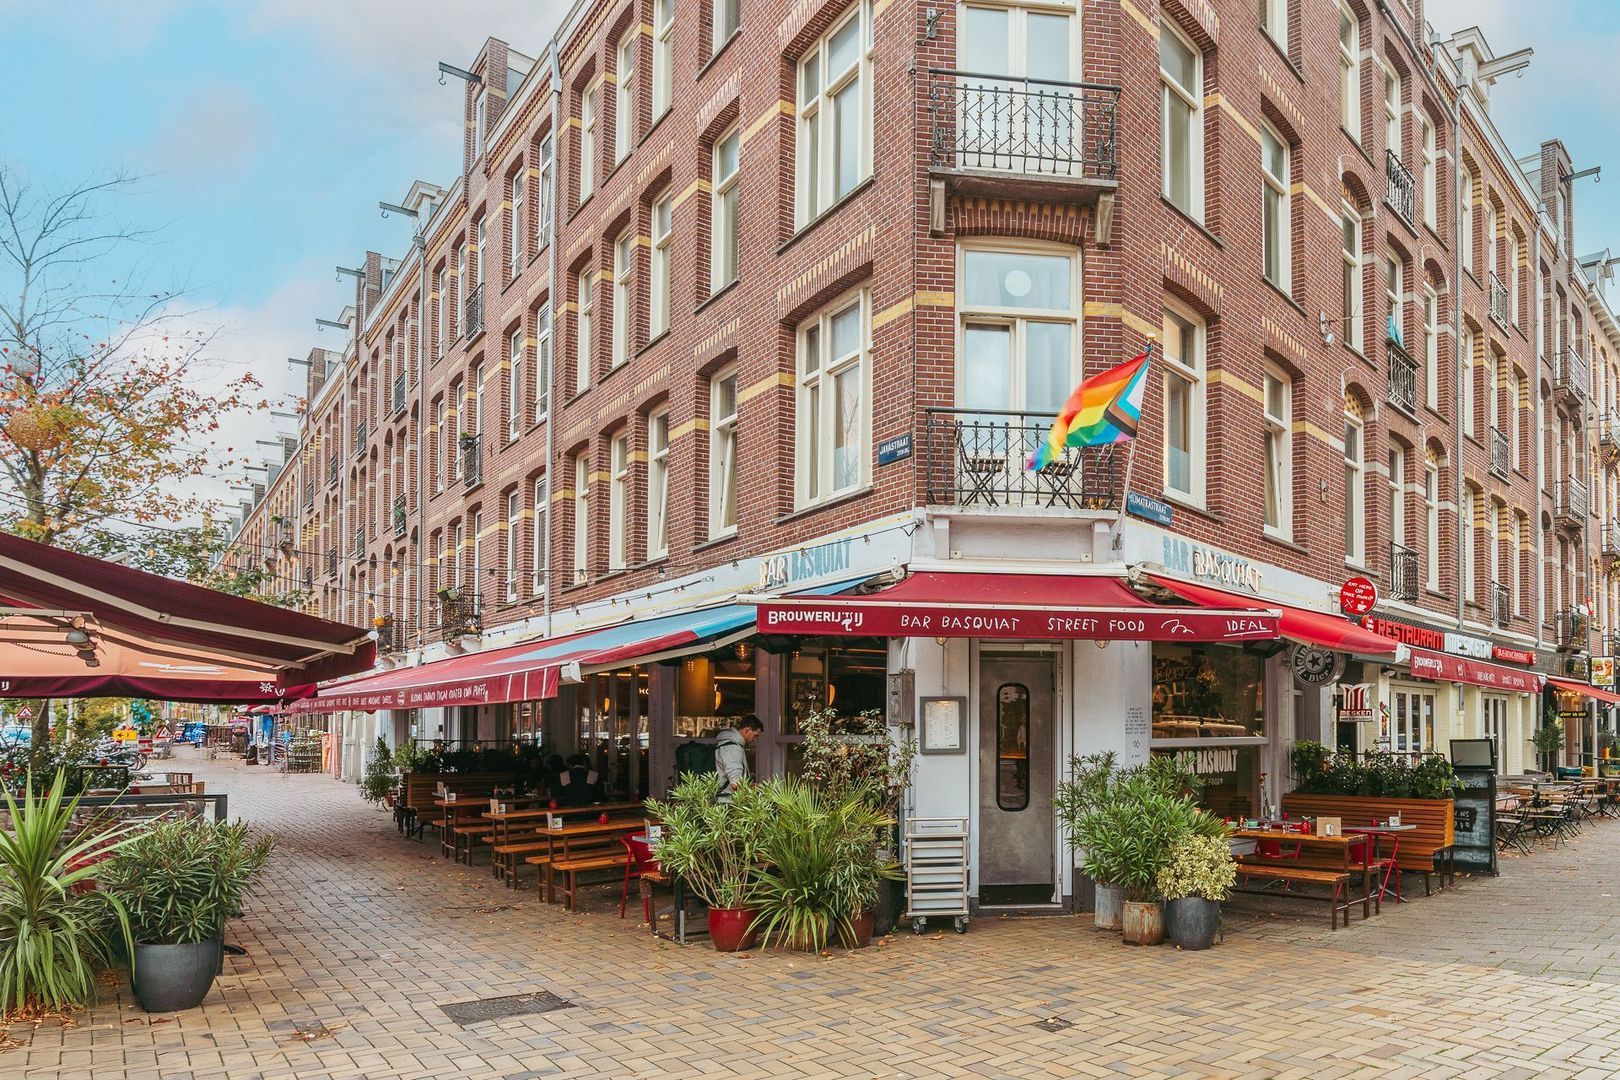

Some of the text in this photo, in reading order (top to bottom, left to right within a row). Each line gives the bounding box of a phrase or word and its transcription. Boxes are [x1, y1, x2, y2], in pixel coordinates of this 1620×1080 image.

[880, 436, 909, 455] JAVASTRAAT
[760, 537, 852, 587] BAR BASQUIAT
[1163, 535, 1263, 594] BAR BASQUIAT
[768, 611, 841, 625] BROUWERIJ
[901, 614, 1020, 631] BAR BASQUIAT
[1048, 617, 1145, 632] STREET FOOD
[1227, 619, 1268, 630] IDEAL
[1309, 670, 1329, 682] Bier
[1196, 750, 1237, 774] BASQUIAT
